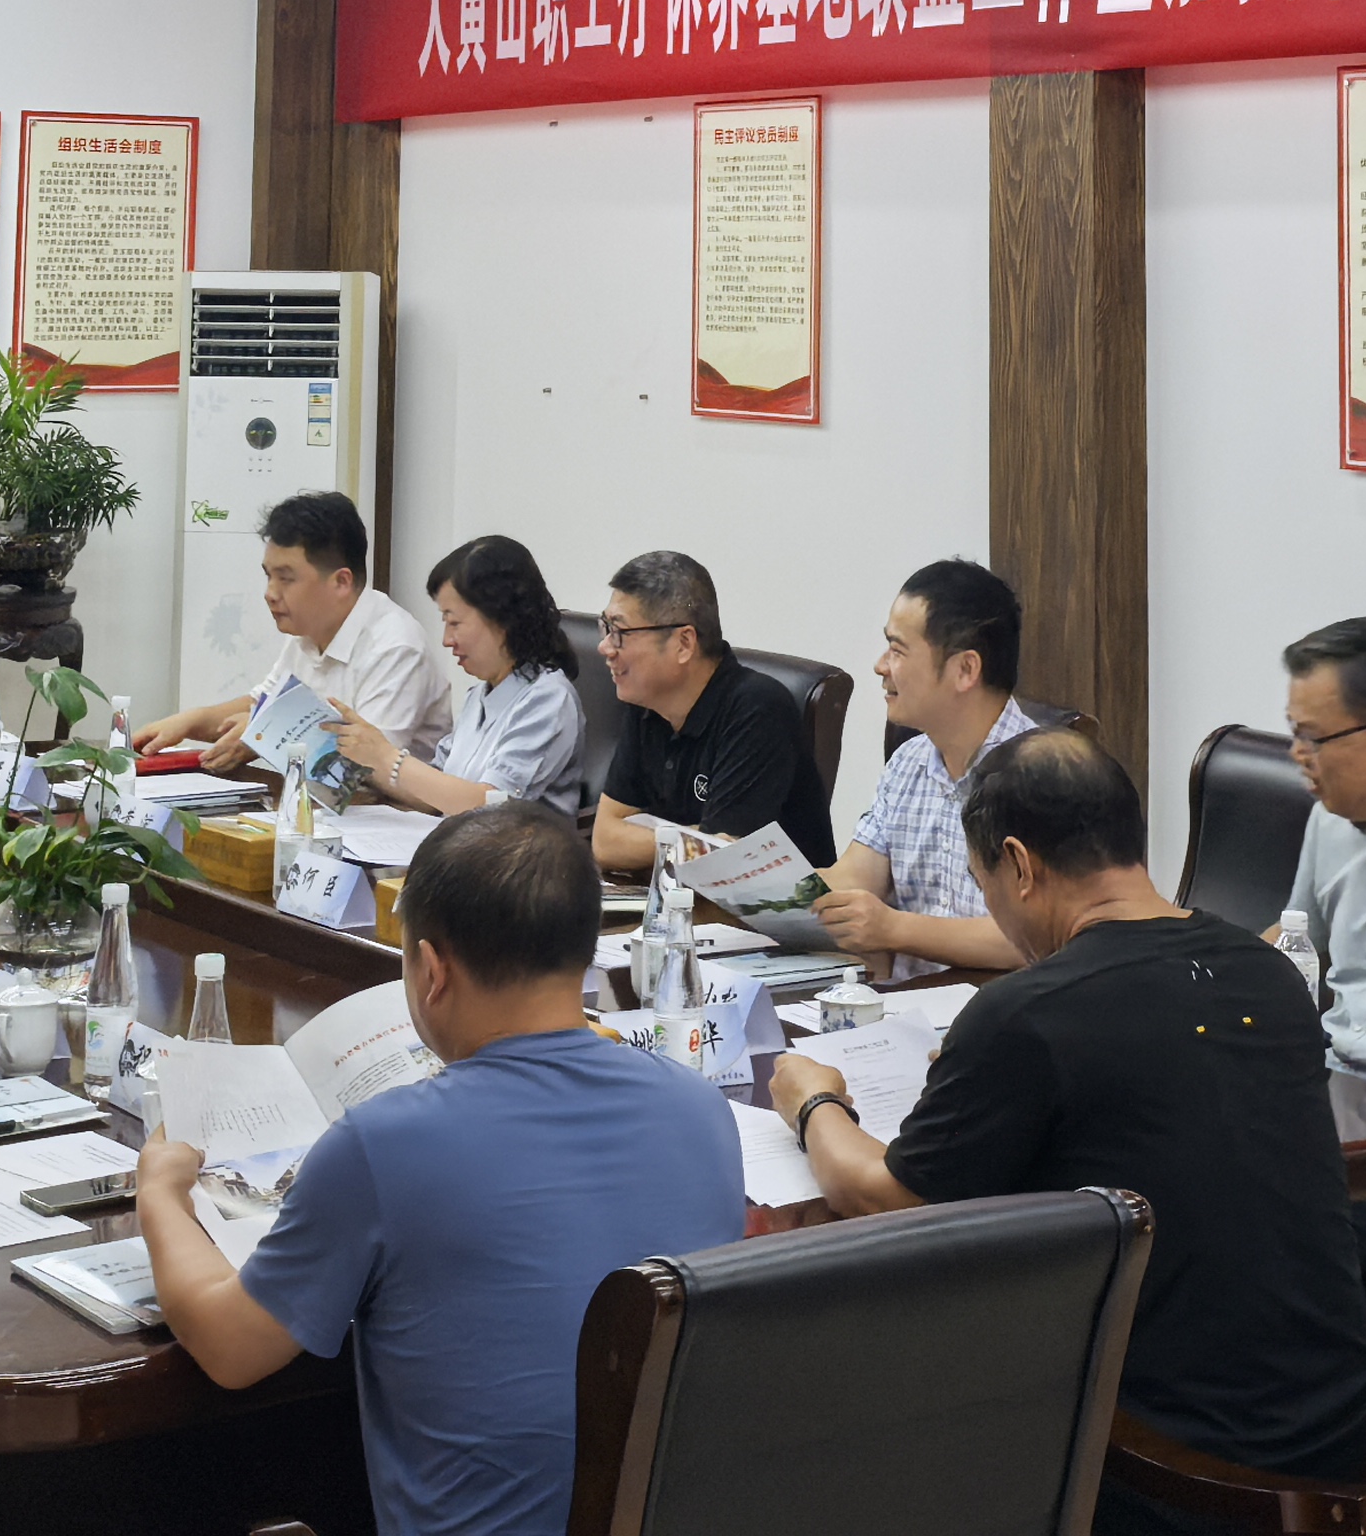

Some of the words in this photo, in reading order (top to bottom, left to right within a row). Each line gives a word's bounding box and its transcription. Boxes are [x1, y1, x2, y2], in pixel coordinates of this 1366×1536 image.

[57, 136, 163, 156] 组织生活会制度
